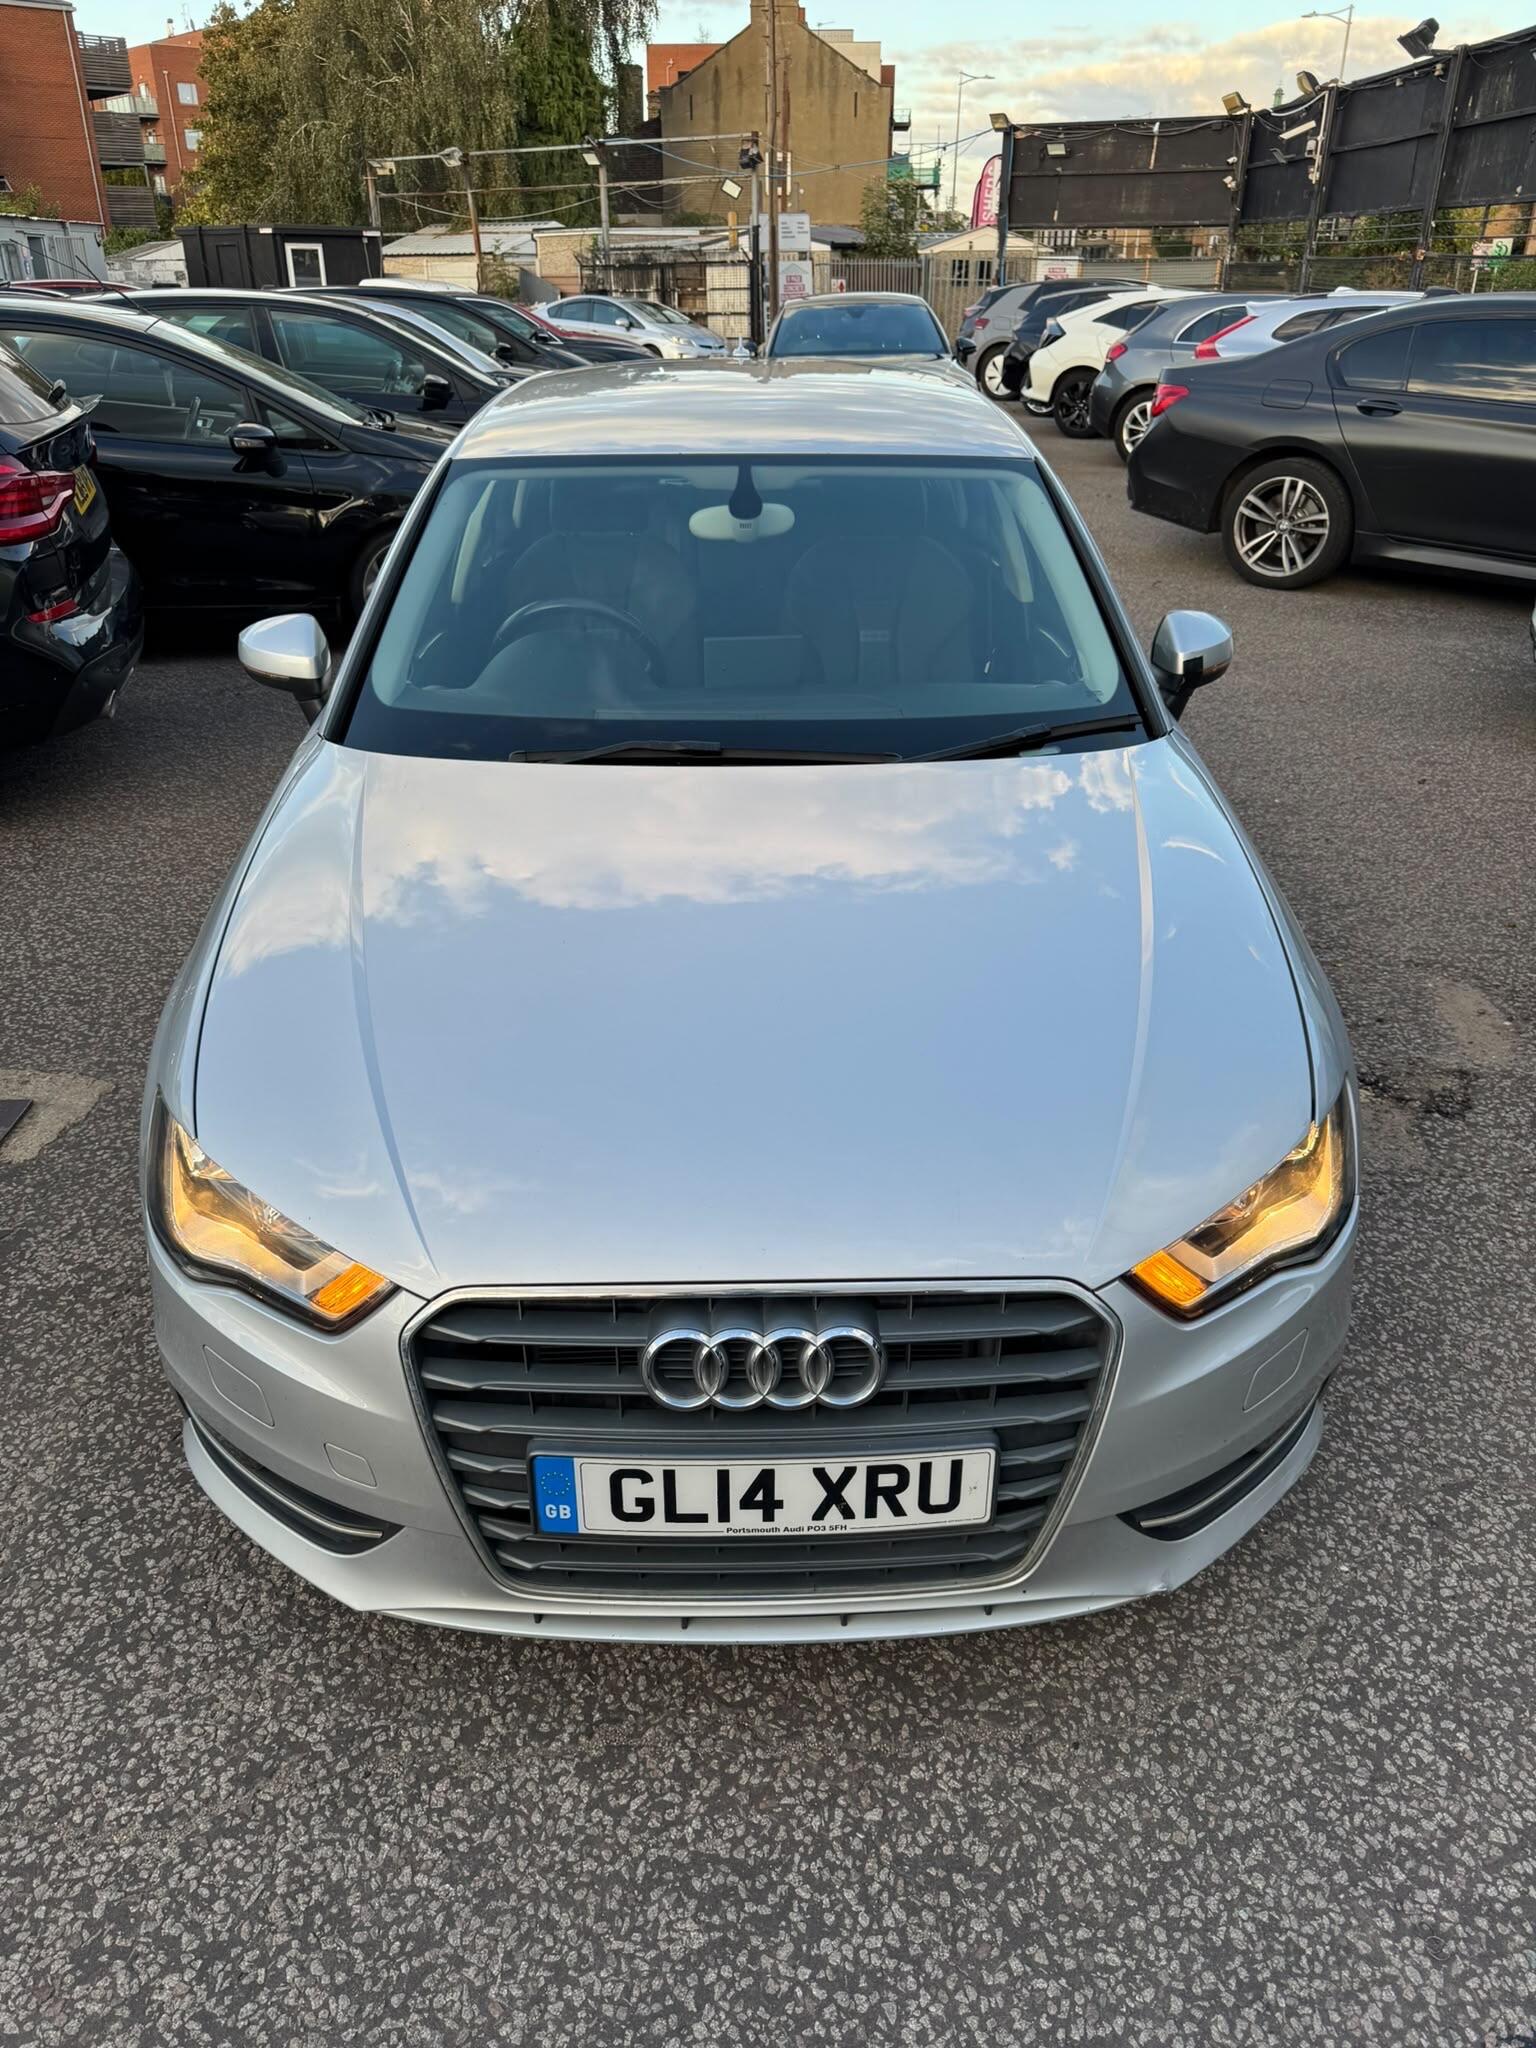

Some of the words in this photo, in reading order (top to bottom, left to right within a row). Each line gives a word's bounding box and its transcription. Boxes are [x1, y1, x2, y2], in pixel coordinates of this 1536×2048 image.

[609, 1468, 784, 1523] GL14
[811, 1459, 963, 1522] XRU
[545, 1504, 571, 1519] GB
[726, 1526, 780, 1534] Portsmouth
[783, 1525, 805, 1533] Audi
